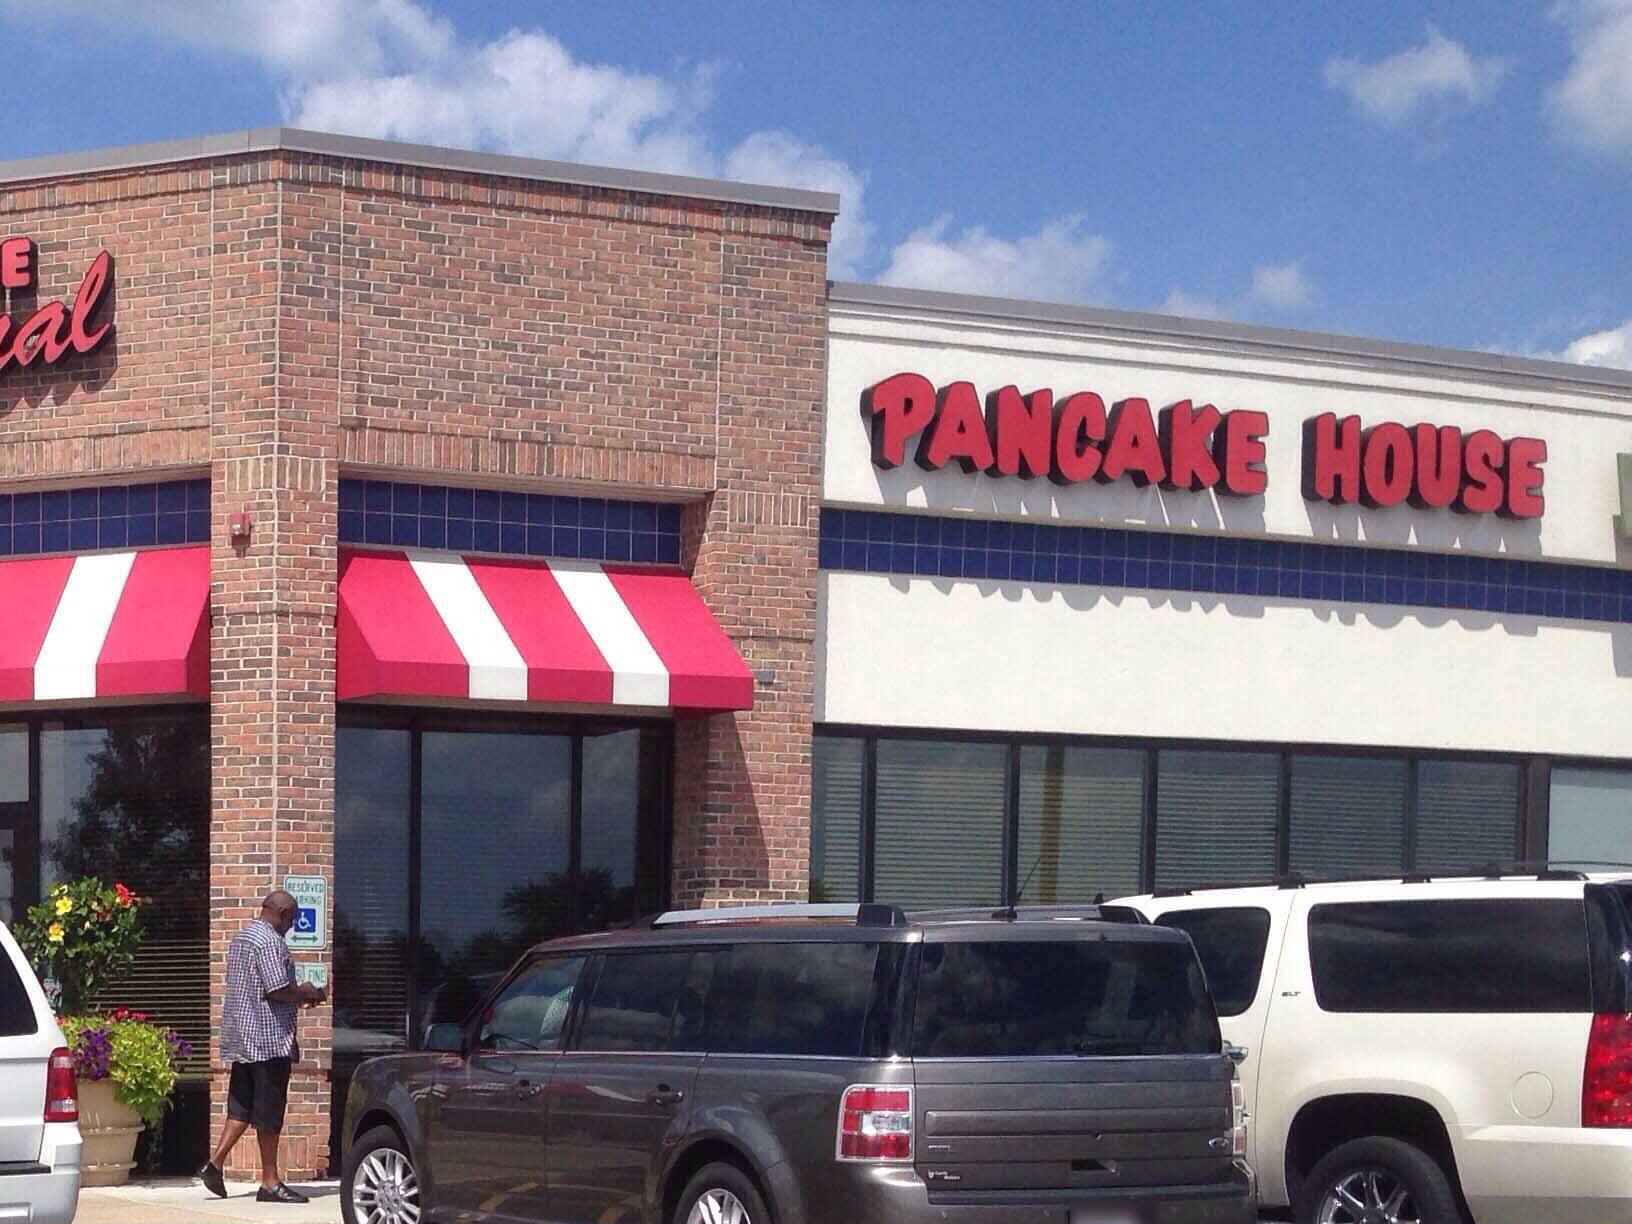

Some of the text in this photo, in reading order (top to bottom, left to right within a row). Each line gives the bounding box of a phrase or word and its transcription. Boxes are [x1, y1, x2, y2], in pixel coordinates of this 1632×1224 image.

[862, 372, 1548, 518] PANCAKE HOUSE
[294, 895, 322, 905] ARKING
